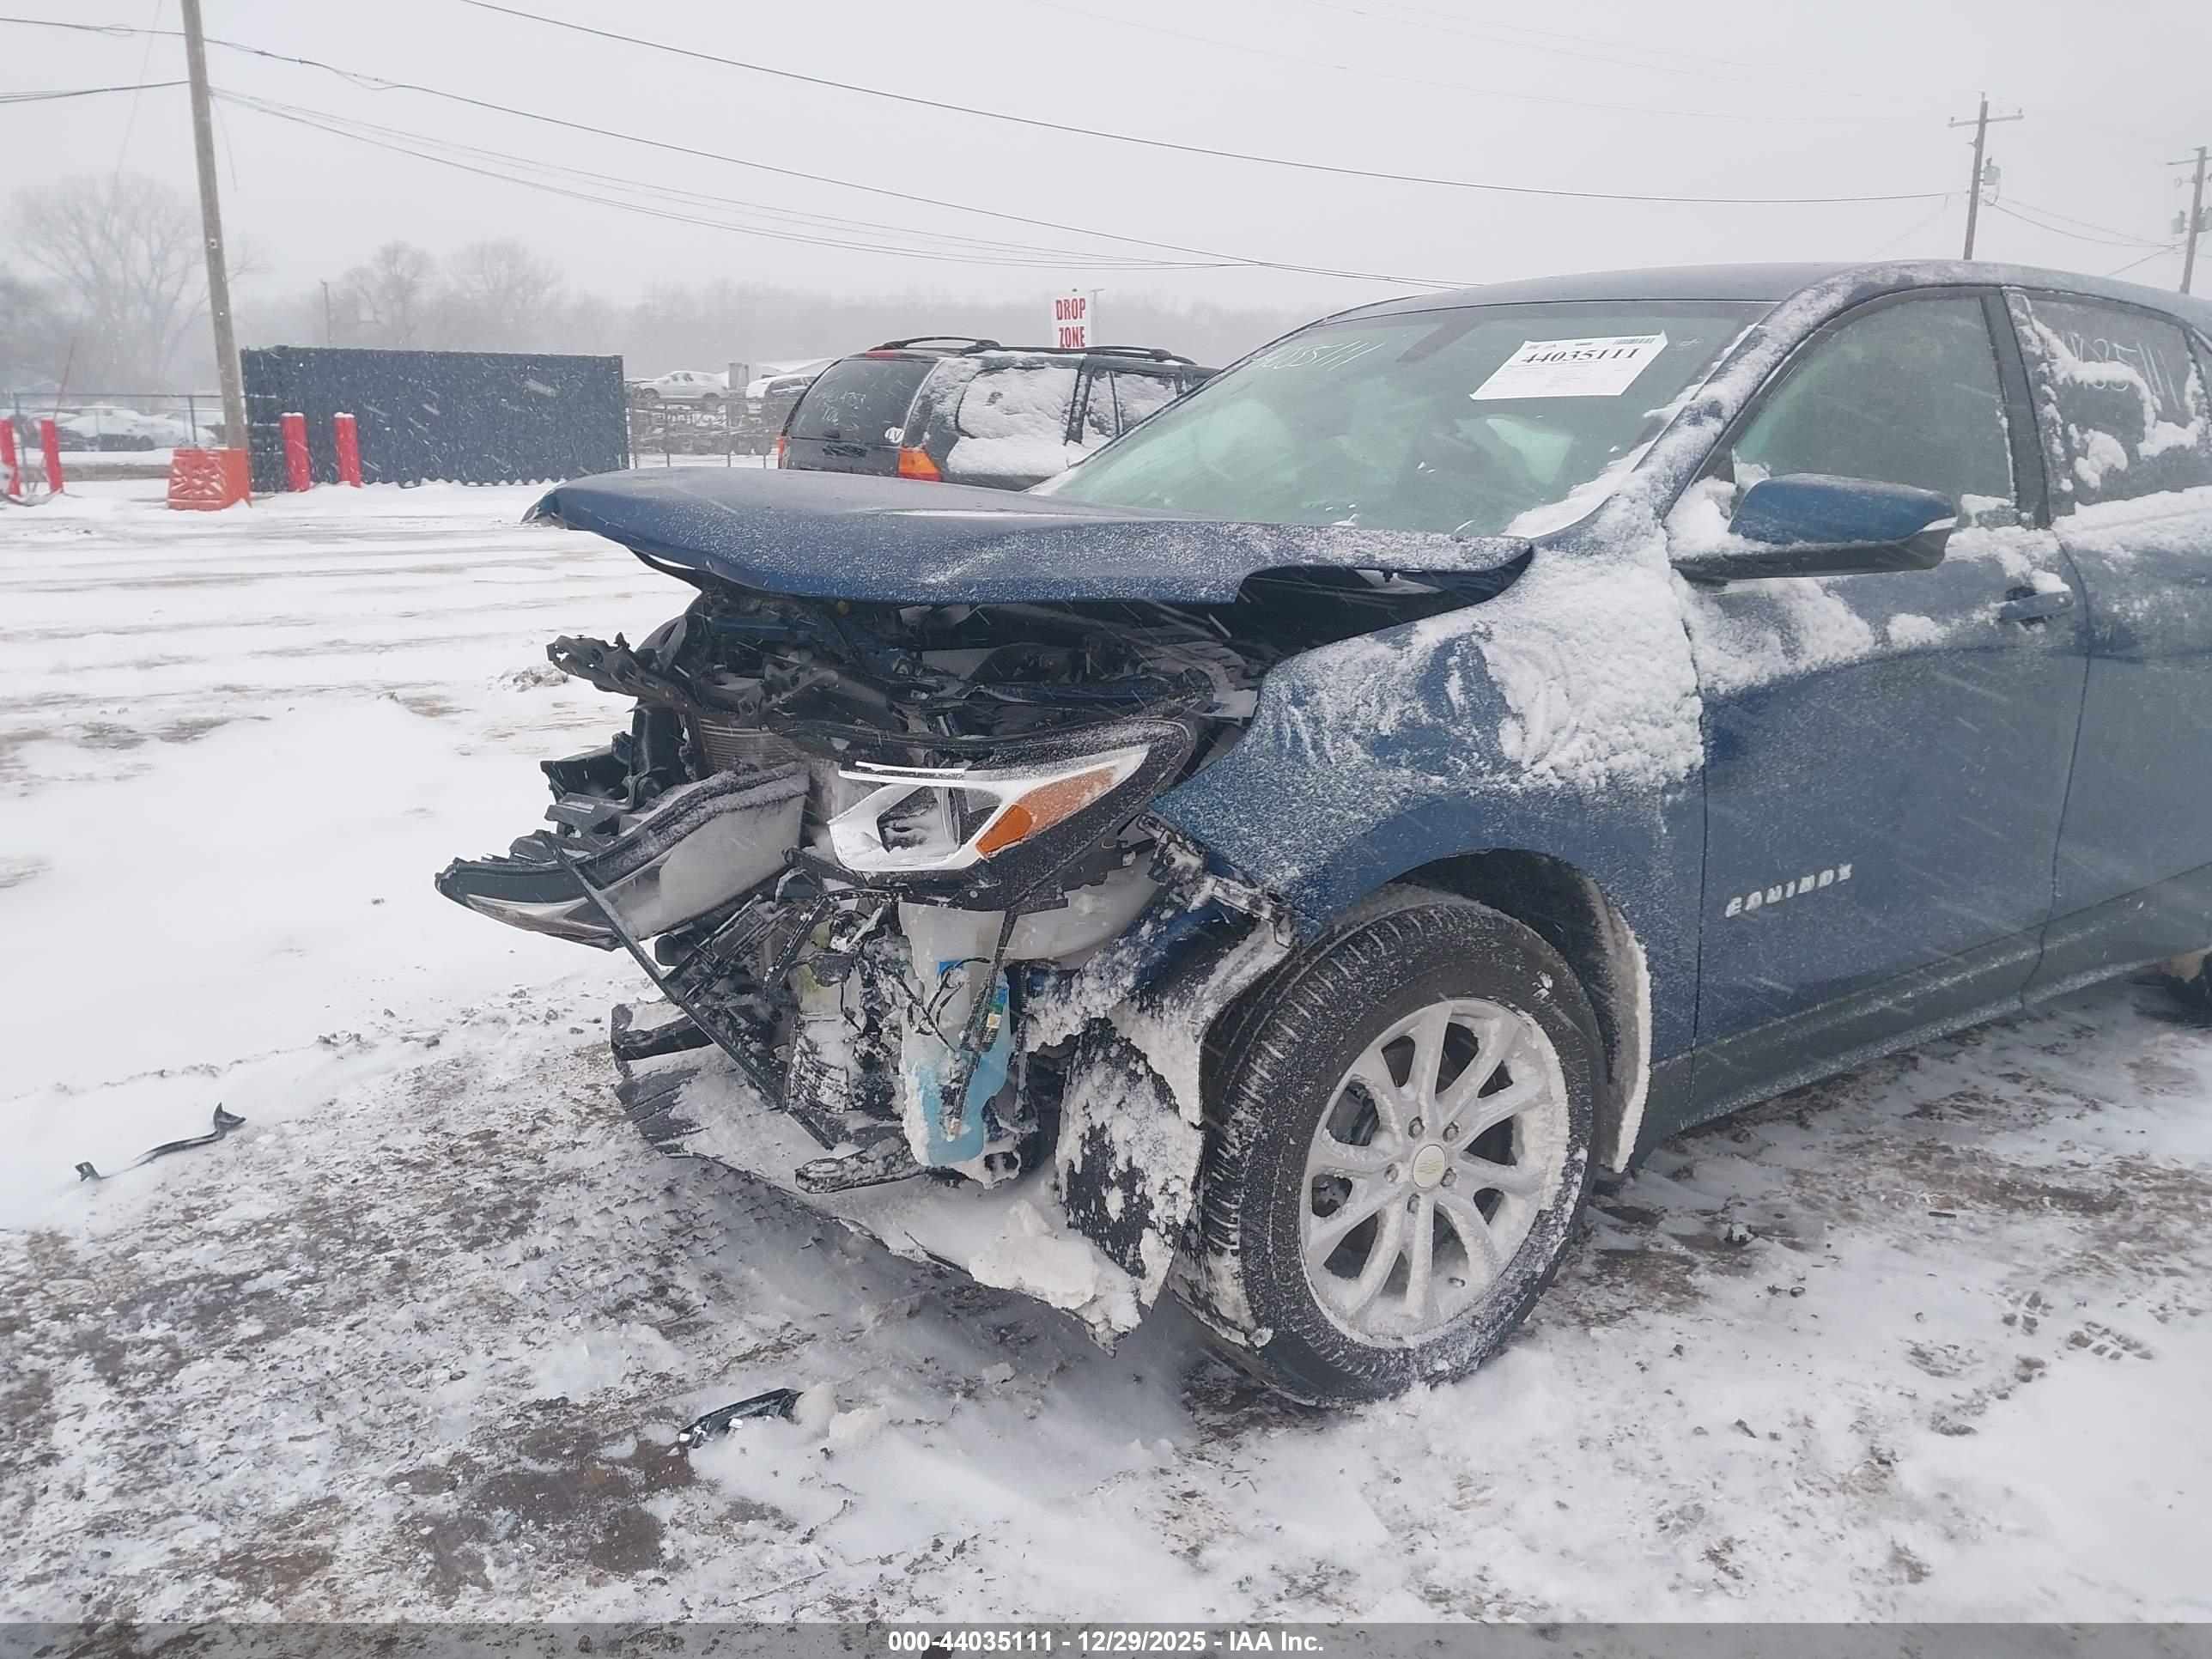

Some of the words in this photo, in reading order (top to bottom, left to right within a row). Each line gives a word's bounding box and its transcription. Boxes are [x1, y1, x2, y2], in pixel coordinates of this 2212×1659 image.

[1055, 297, 1086, 321] DROP
[1058, 325, 1086, 348] ZONE
[1522, 347, 1640, 363] 44035111
[1724, 863, 1852, 918] EQUINOX
